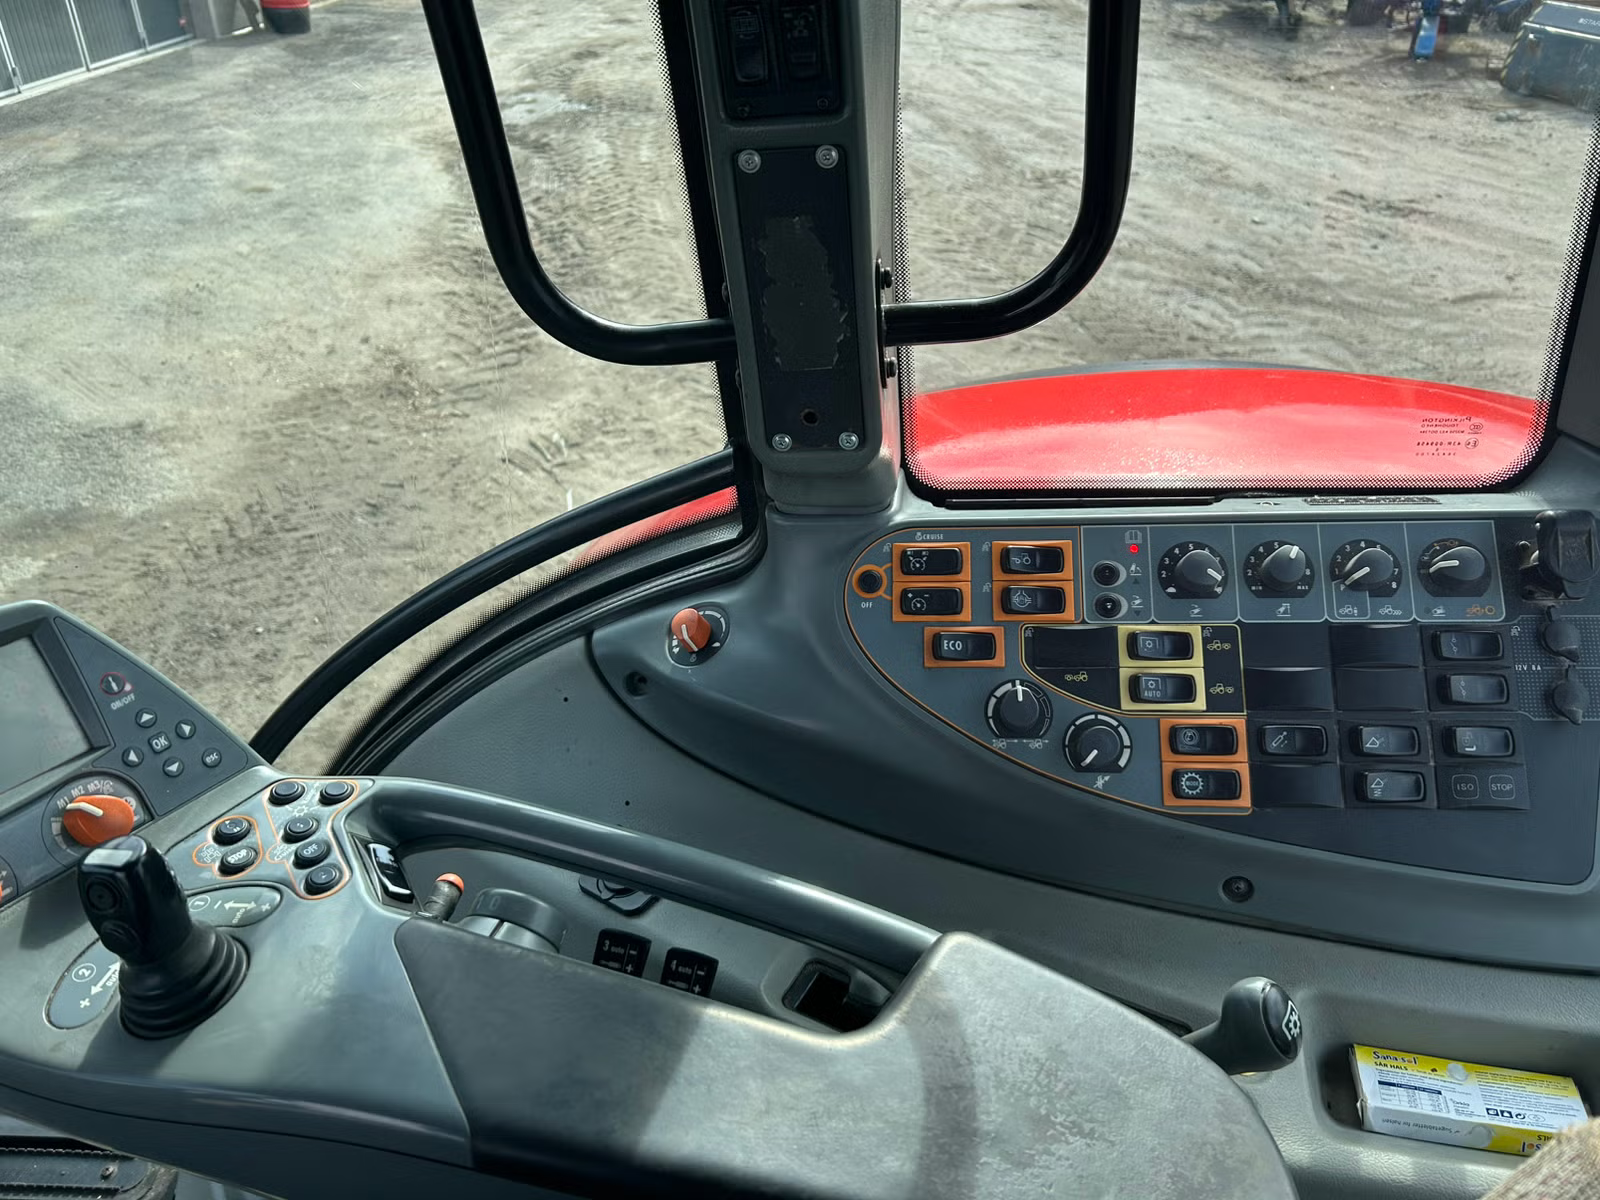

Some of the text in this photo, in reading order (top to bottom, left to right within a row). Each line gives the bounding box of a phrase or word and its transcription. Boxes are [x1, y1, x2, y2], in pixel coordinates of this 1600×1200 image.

[1273, 541, 1279, 549] 5
[1344, 544, 1351, 552] 3
[1359, 540, 1366, 548] 4
[1258, 545, 1264, 553] 4
[1163, 557, 1170, 565] 3
[1161, 570, 1167, 578] 2
[1391, 581, 1398, 589] 8
[861, 601, 873, 609] OFF
[943, 639, 963, 651] ECO
[110, 693, 136, 710] ON/OFF
[152, 736, 168, 750] OK
[205, 752, 219, 763] esc
[1456, 783, 1474, 791] ISO
[1491, 783, 1513, 791] STOP
[56, 796, 70, 809] M1
[71, 786, 85, 798] M2
[303, 843, 319, 856] OFF
[227, 848, 248, 864] STOP
[232, 907, 246, 924] auto
[602, 939, 610, 951] 3
[670, 959, 677, 971] 4
[78, 968, 92, 977] 2
